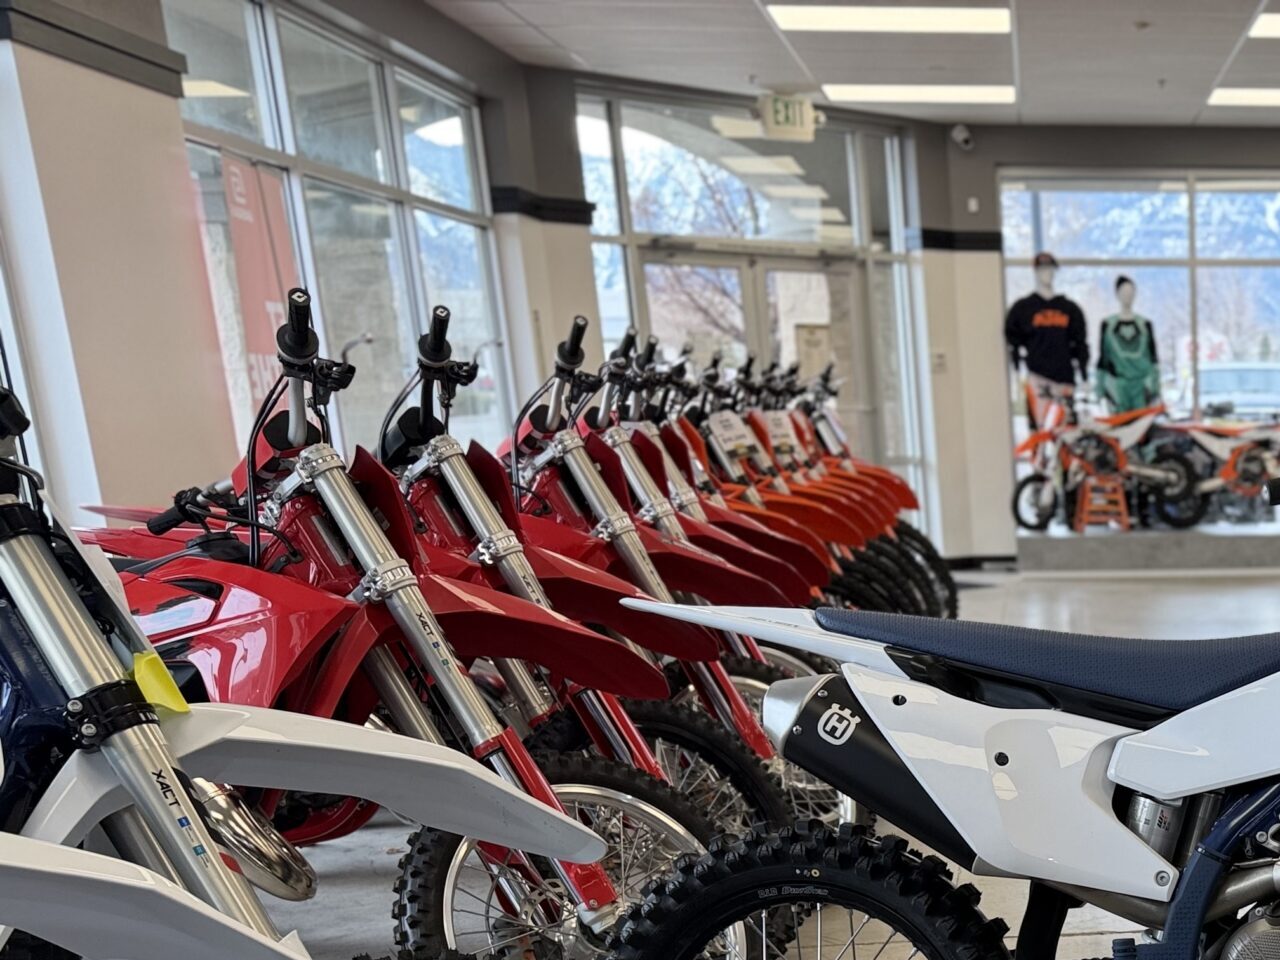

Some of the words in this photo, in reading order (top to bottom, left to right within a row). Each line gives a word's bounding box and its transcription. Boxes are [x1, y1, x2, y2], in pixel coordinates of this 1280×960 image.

[772, 96, 805, 127] EXIT
[416, 612, 434, 636] XACT
[151, 769, 180, 807] XACT
